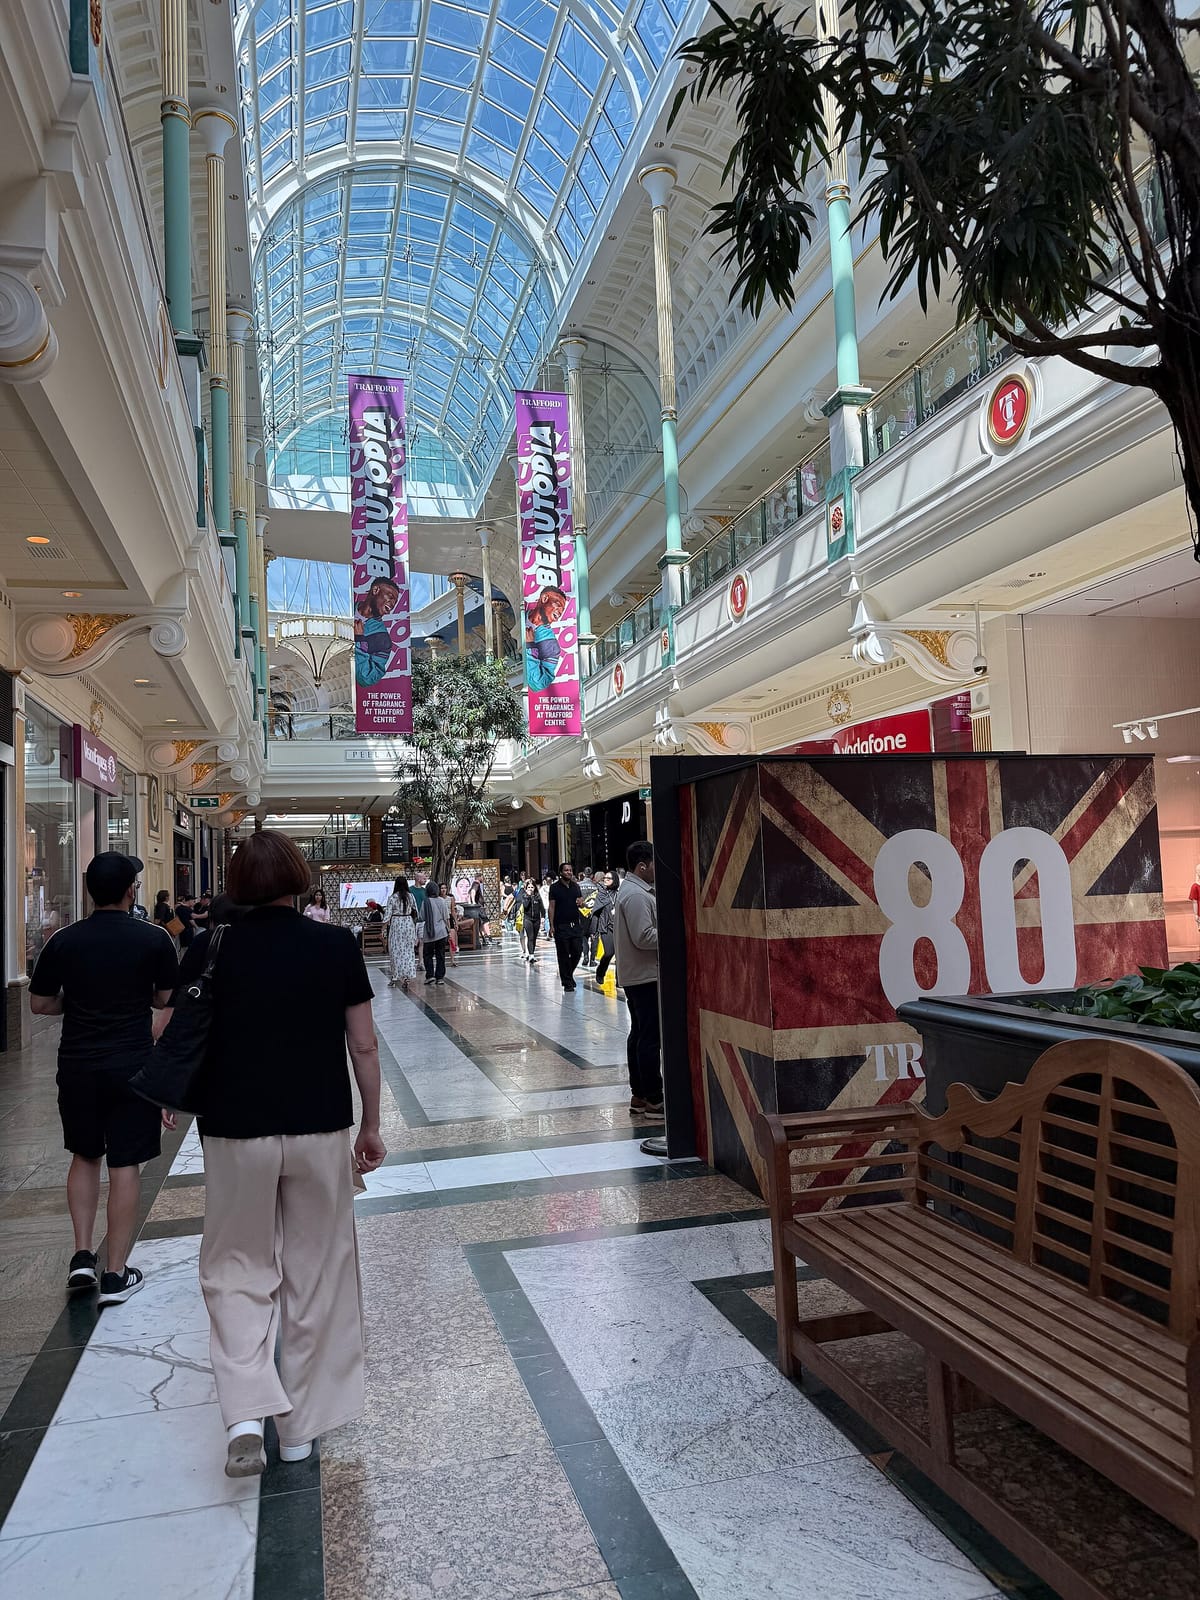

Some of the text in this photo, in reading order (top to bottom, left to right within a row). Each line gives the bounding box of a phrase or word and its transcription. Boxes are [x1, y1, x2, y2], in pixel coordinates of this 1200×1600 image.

[354, 383, 397, 392] TRAFFORD
[521, 399, 561, 408] TRAFFORD
[363, 411, 392, 577] BEAUTOPIA
[529, 426, 559, 586] BEAUTOPIA
[368, 692, 401, 700] THE POWER
[371, 700, 406, 708] FRAGRANCE
[374, 708, 404, 716] TRAFFORD
[545, 711, 573, 719] TRAFFORD
[352, 751, 380, 759] PEEL
[622, 801, 630, 824] JD
[873, 826, 1077, 1010] 80
